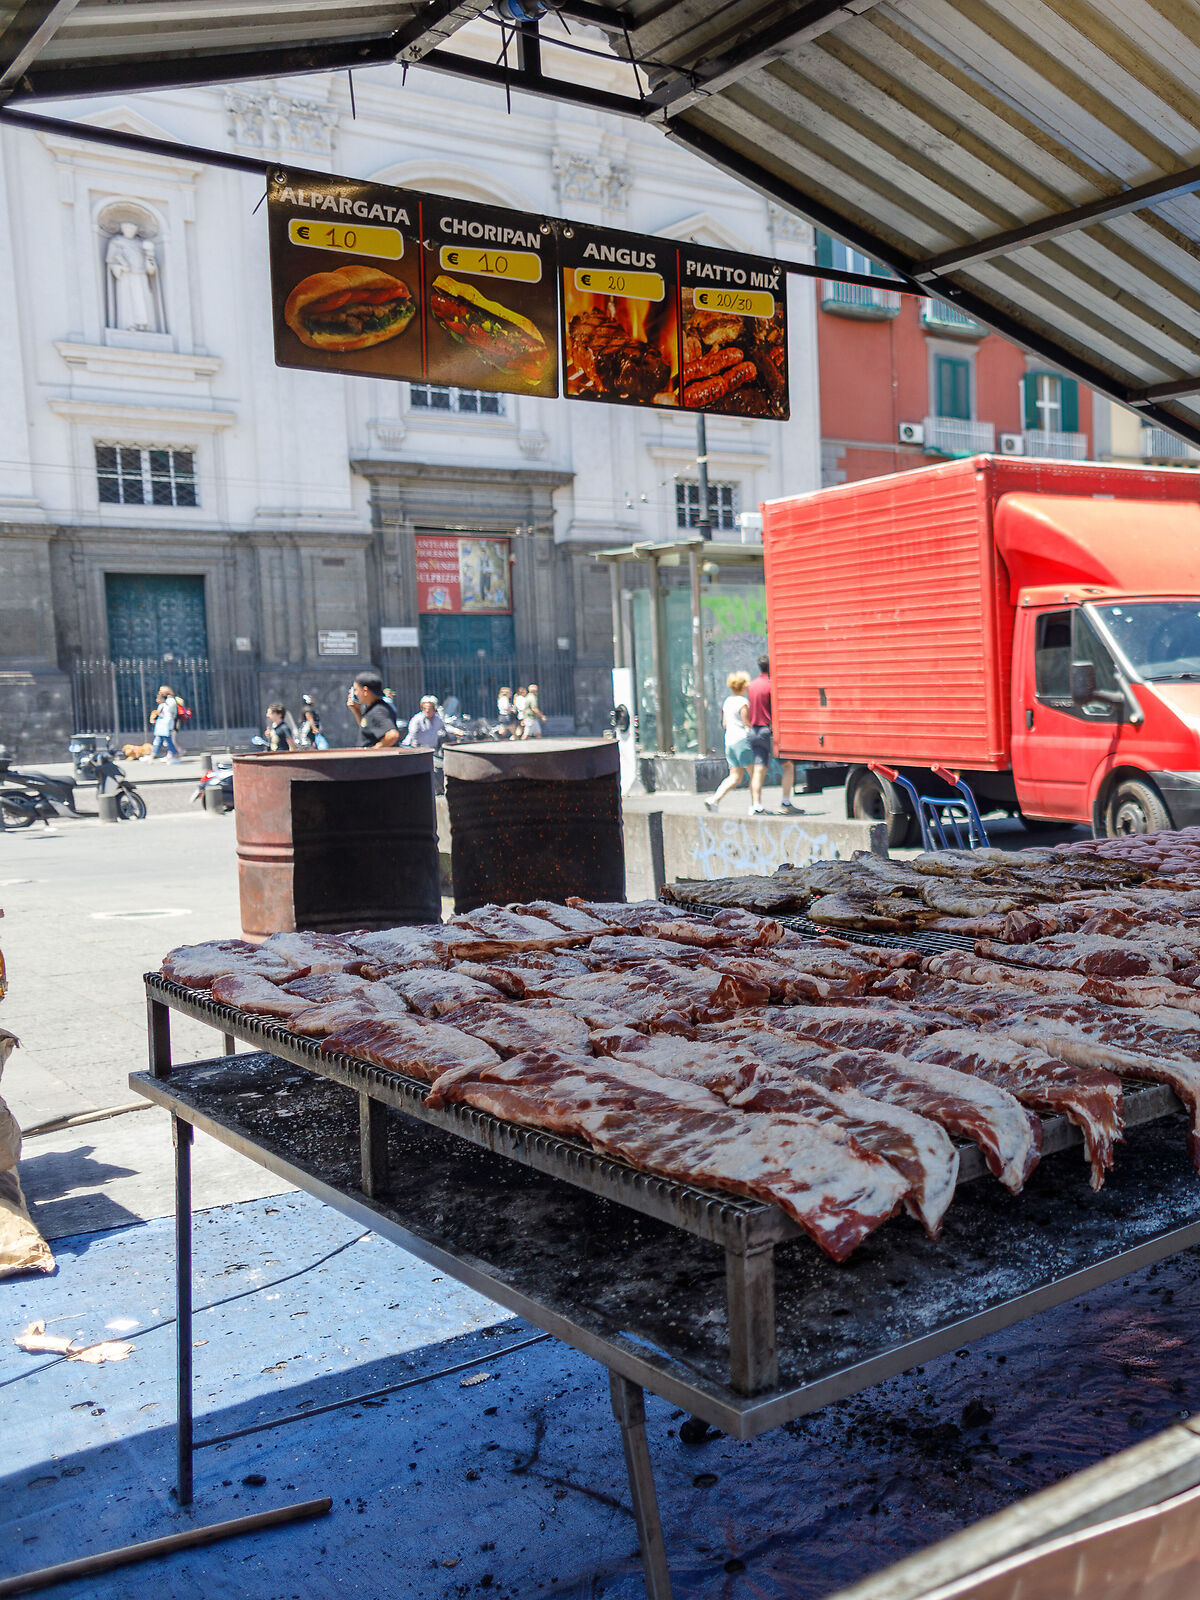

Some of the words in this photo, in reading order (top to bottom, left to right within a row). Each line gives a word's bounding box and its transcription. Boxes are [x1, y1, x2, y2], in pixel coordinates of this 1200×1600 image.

[279, 186, 411, 226] ALPARGATA
[296, 226, 310, 240] €
[325, 227, 357, 249] 10
[439, 216, 542, 250] CHORIPAN
[446, 252, 459, 265] €
[478, 253, 508, 274] 10
[582, 242, 657, 270] ANGUS
[580, 274, 591, 287] €
[607, 275, 626, 292] 20
[685, 259, 747, 285] PIATTO
[749, 271, 780, 291] MIX
[698, 293, 709, 305] €
[716, 293, 753, 312] 20/30
